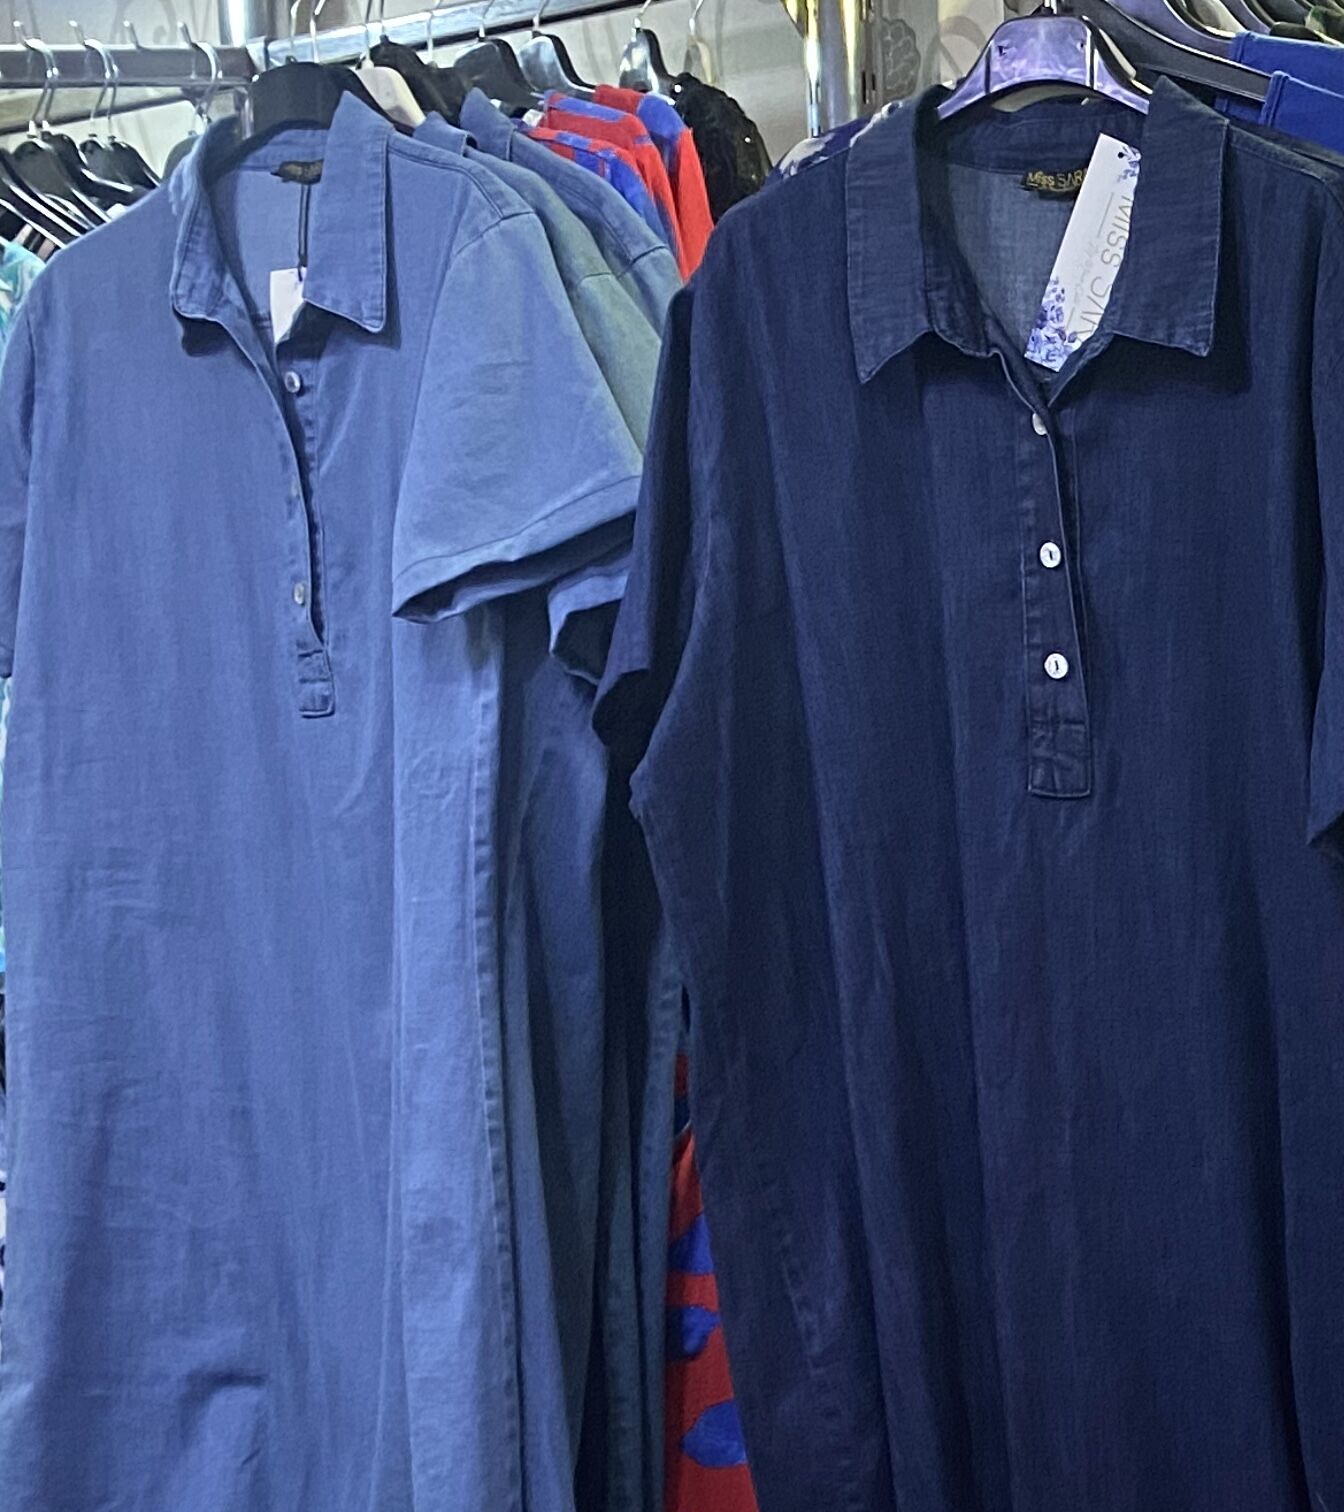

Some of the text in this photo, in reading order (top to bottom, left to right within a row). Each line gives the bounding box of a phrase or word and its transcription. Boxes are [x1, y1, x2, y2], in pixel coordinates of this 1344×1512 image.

[1056, 169, 1085, 188] SAR
[1100, 195, 1134, 267] MISS
[1075, 276, 1112, 341] SAR
